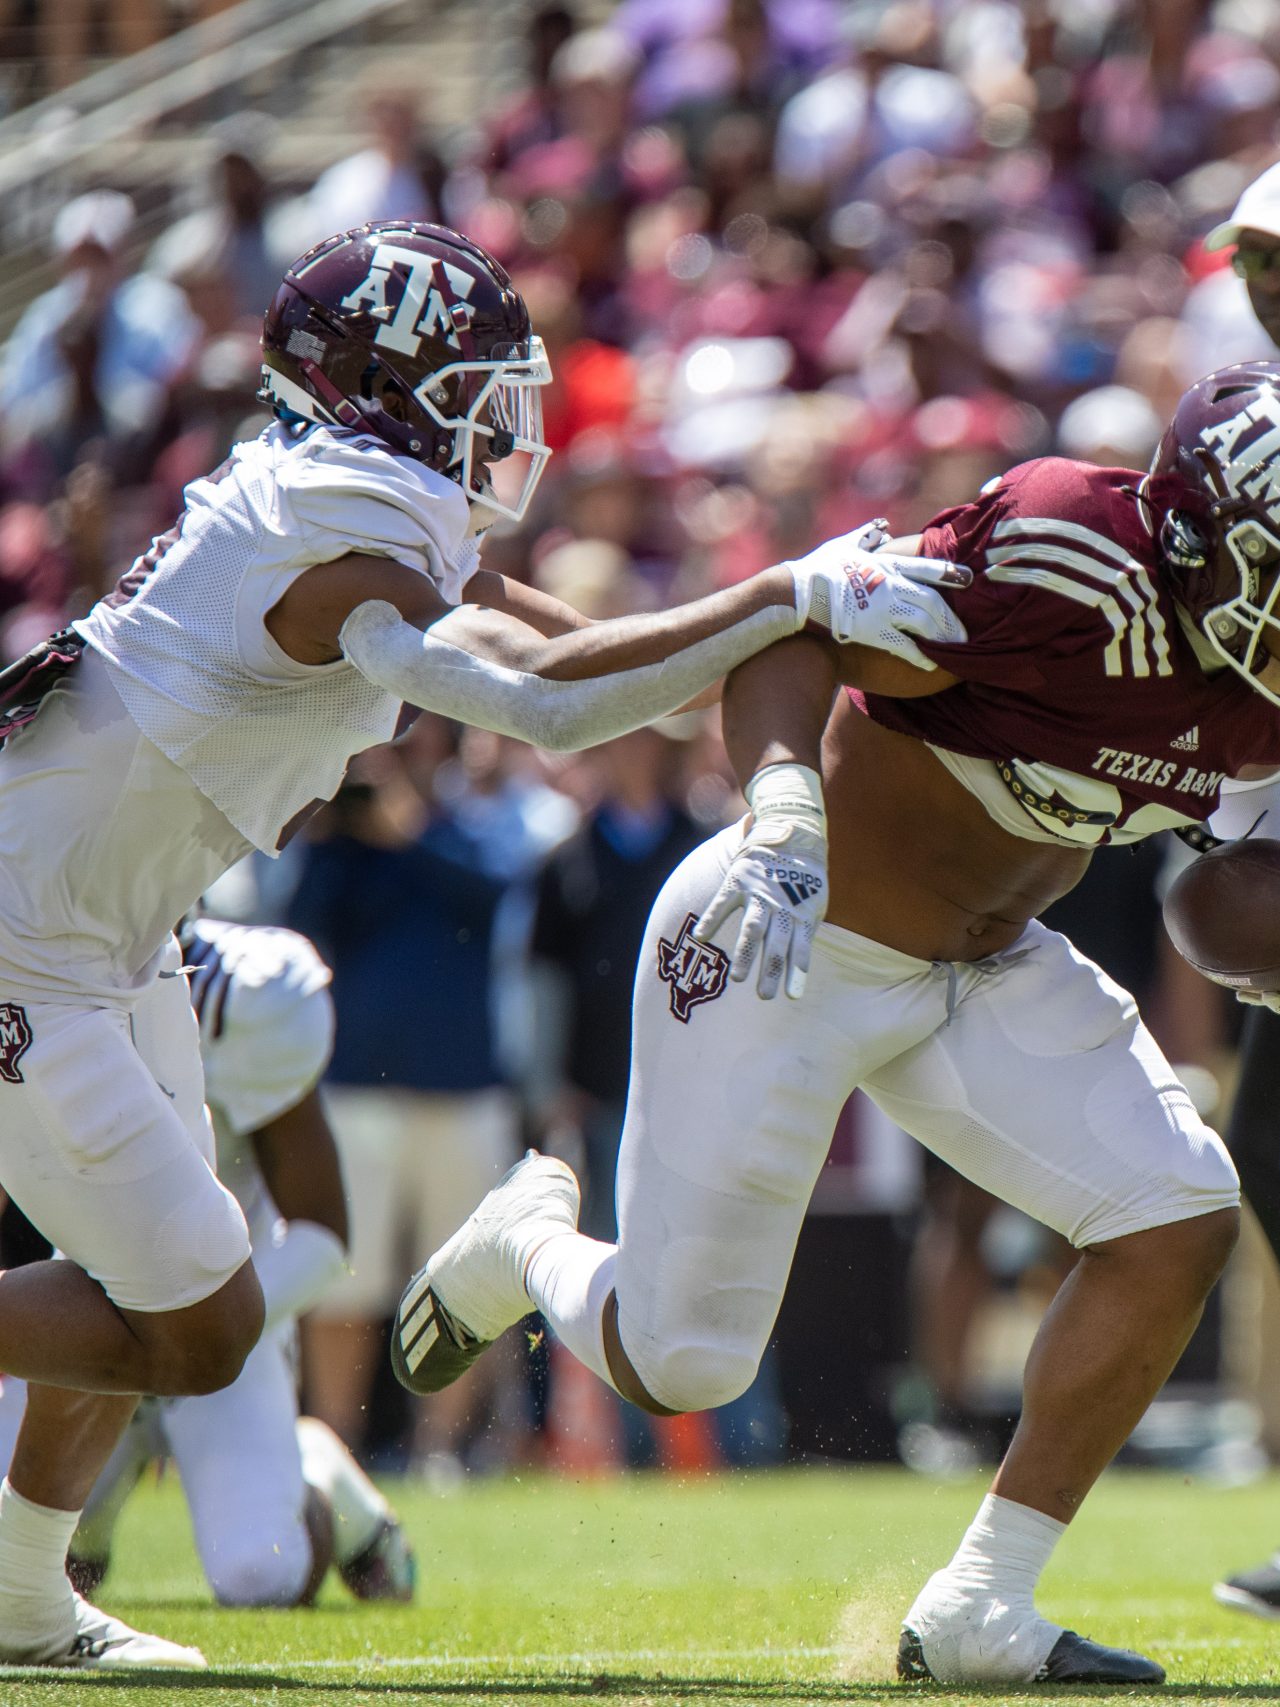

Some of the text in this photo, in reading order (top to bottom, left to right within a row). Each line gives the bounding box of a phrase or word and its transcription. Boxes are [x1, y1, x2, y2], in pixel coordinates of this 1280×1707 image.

[1169, 740, 1199, 752] adidas
[1091, 746, 1226, 798] TEXAS A&M
[764, 868, 822, 888] adidas
